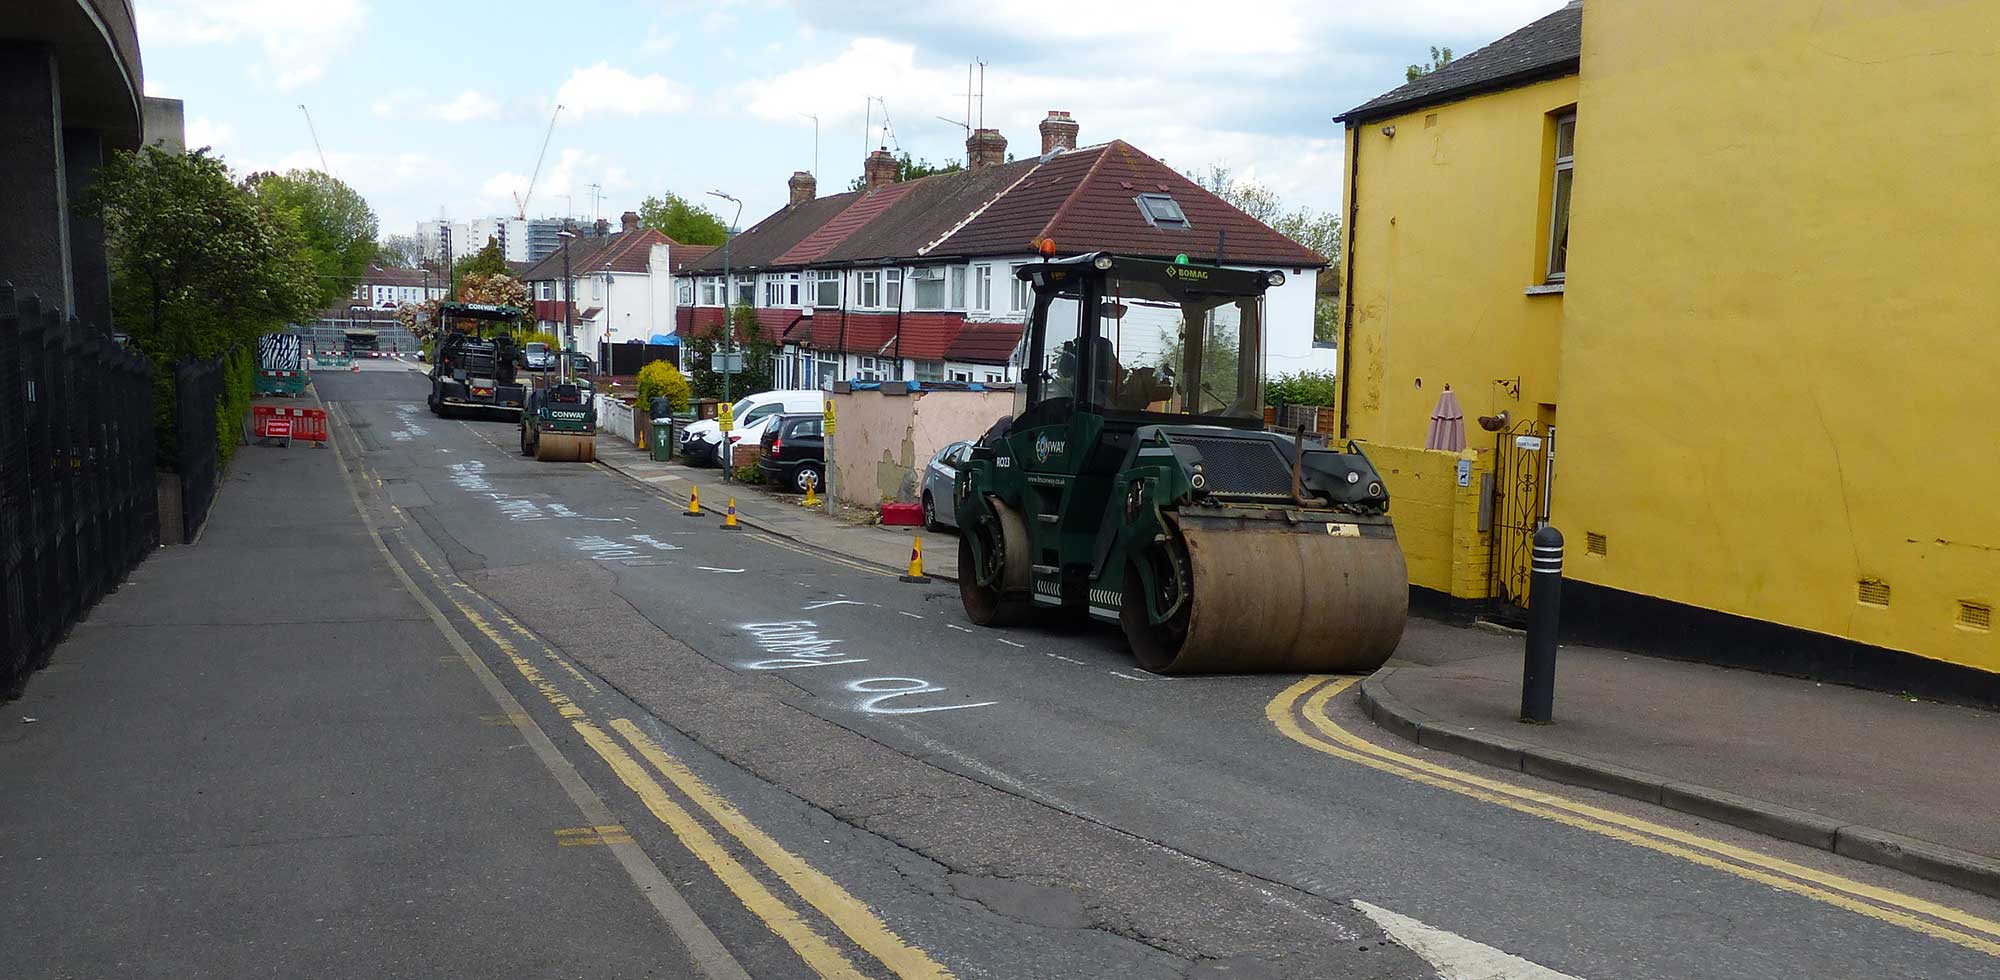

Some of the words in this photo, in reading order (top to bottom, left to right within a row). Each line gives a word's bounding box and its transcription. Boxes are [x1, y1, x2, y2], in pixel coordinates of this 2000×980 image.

[1178, 268, 1208, 279] BOMAG
[468, 303, 497, 311] CONWAY
[551, 411, 586, 419] CONWAY
[1036, 440, 1065, 453] CONWAY
